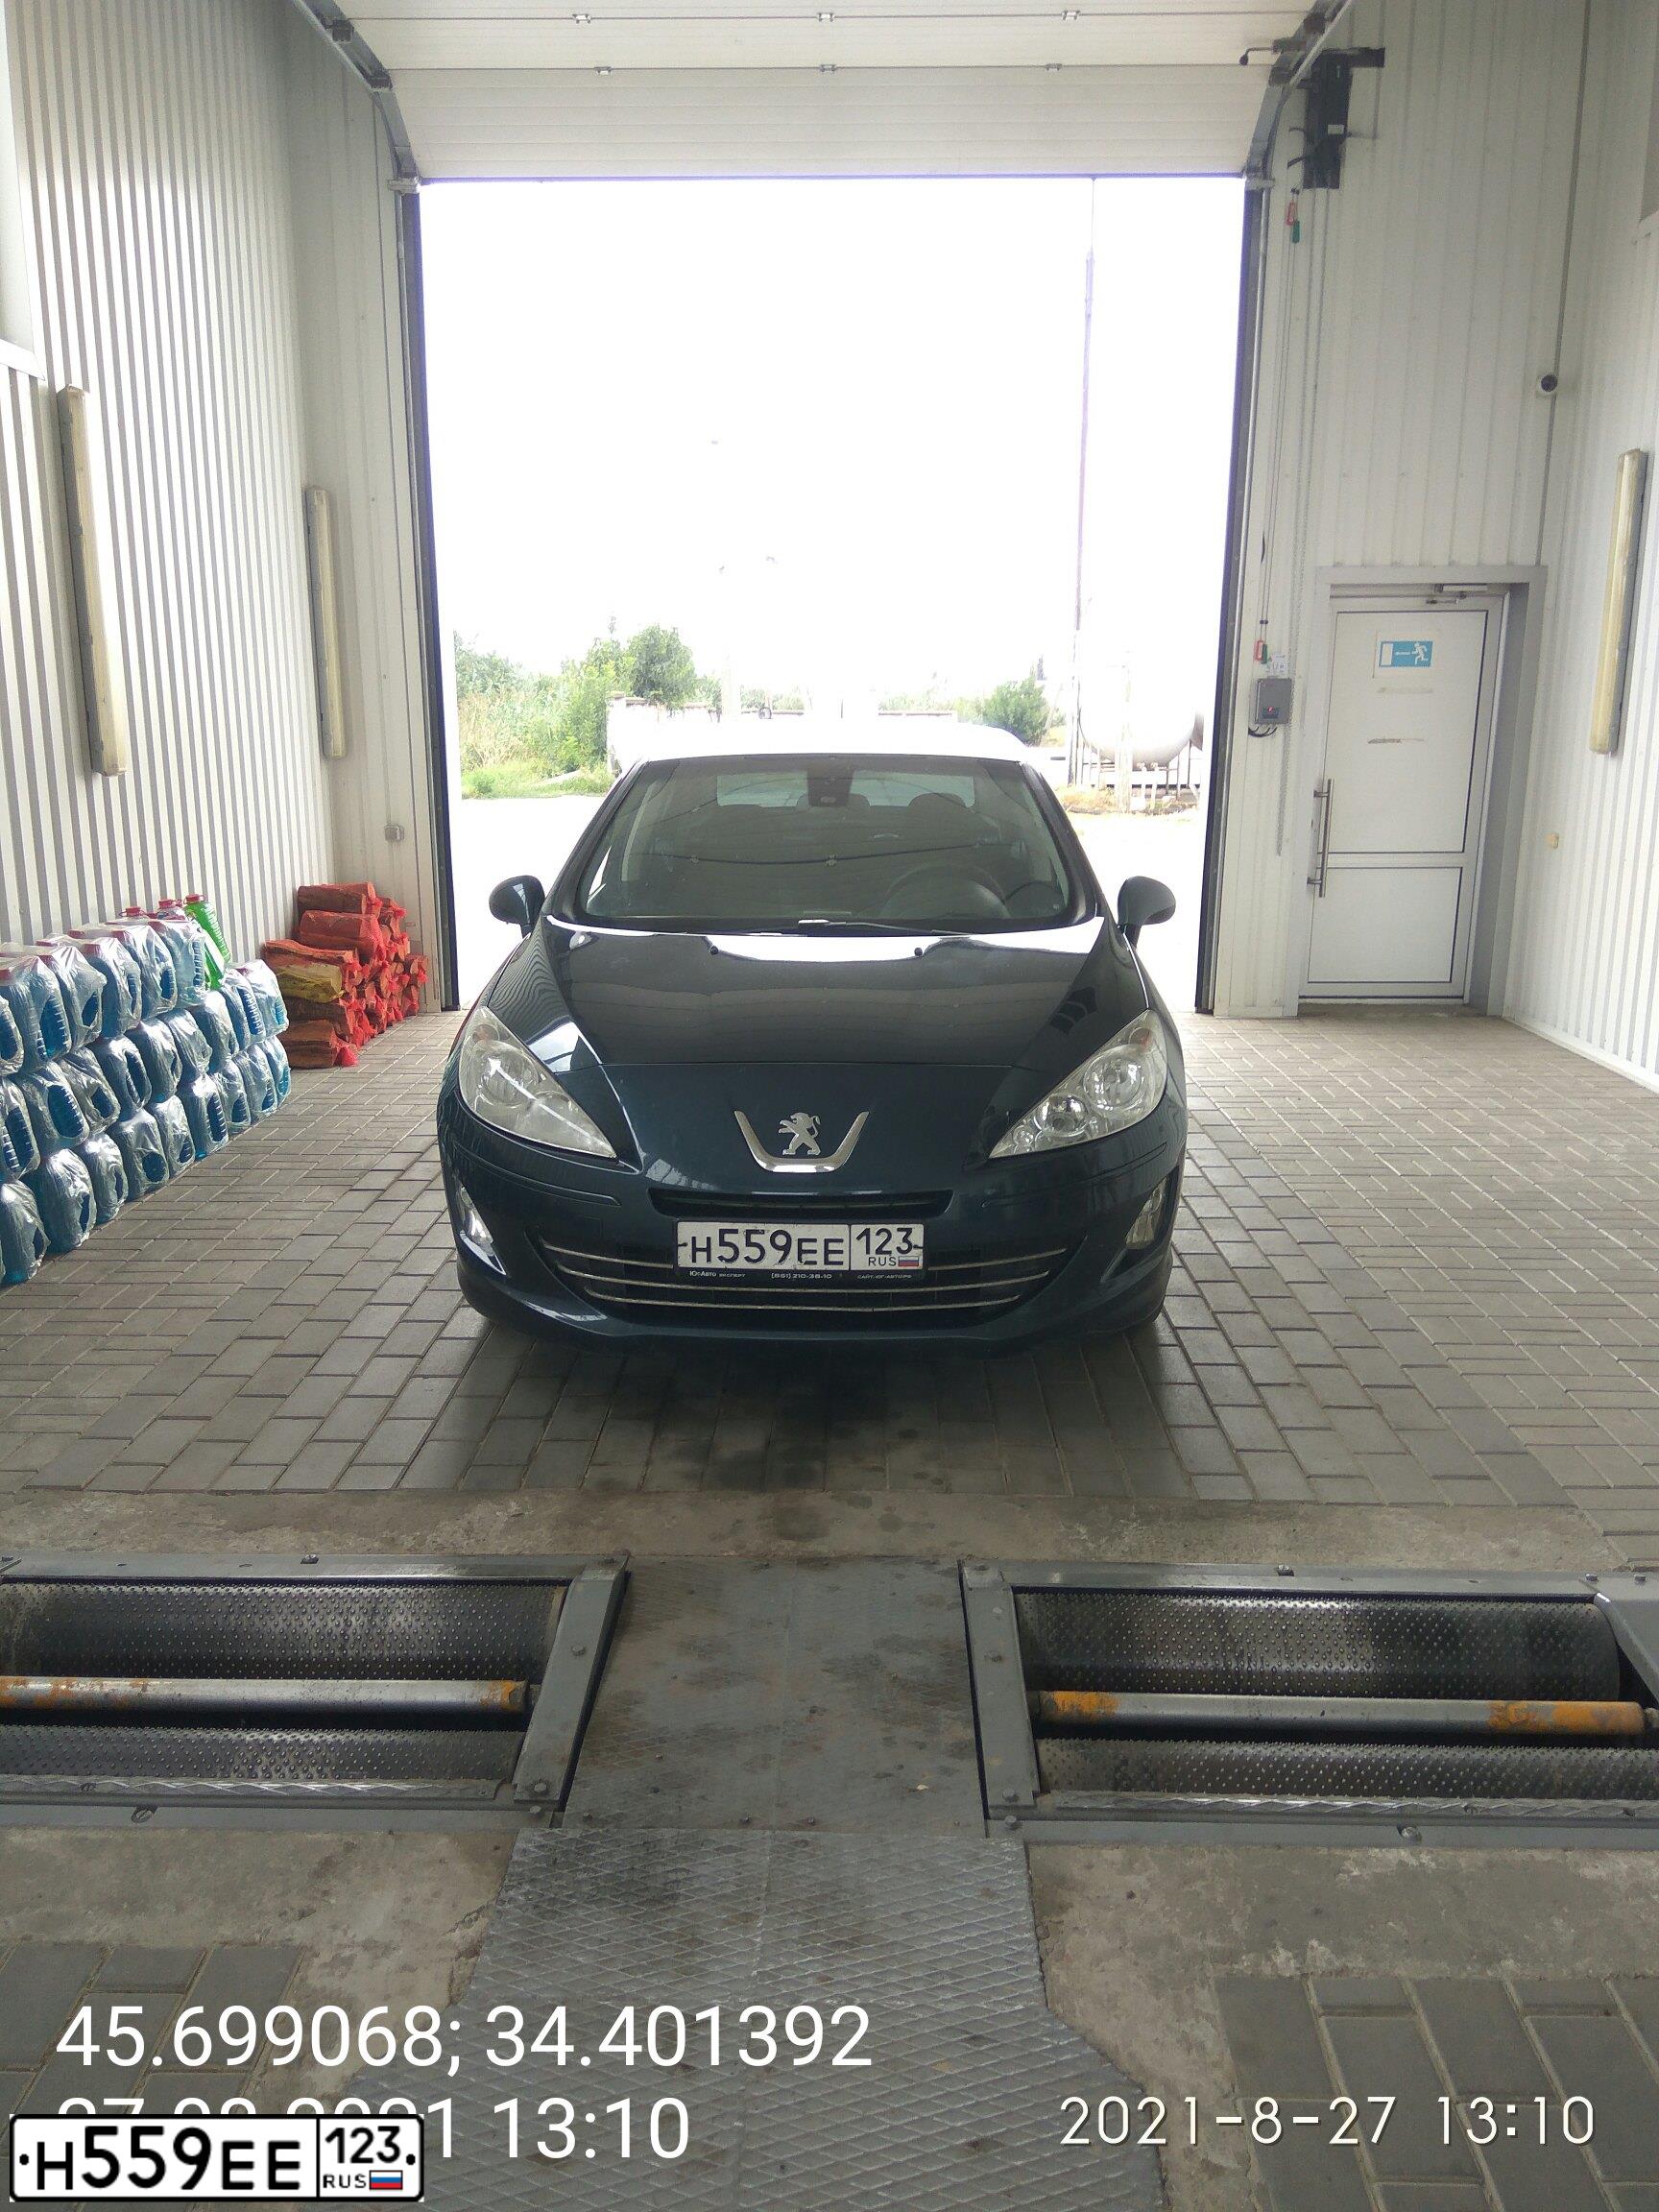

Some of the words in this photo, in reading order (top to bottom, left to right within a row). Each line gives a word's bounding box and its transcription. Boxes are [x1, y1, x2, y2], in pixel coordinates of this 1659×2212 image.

[691, 1228, 844, 1266] Н559ЕЕ
[855, 1227, 912, 1256] 123
[868, 1256, 897, 1266] RUS
